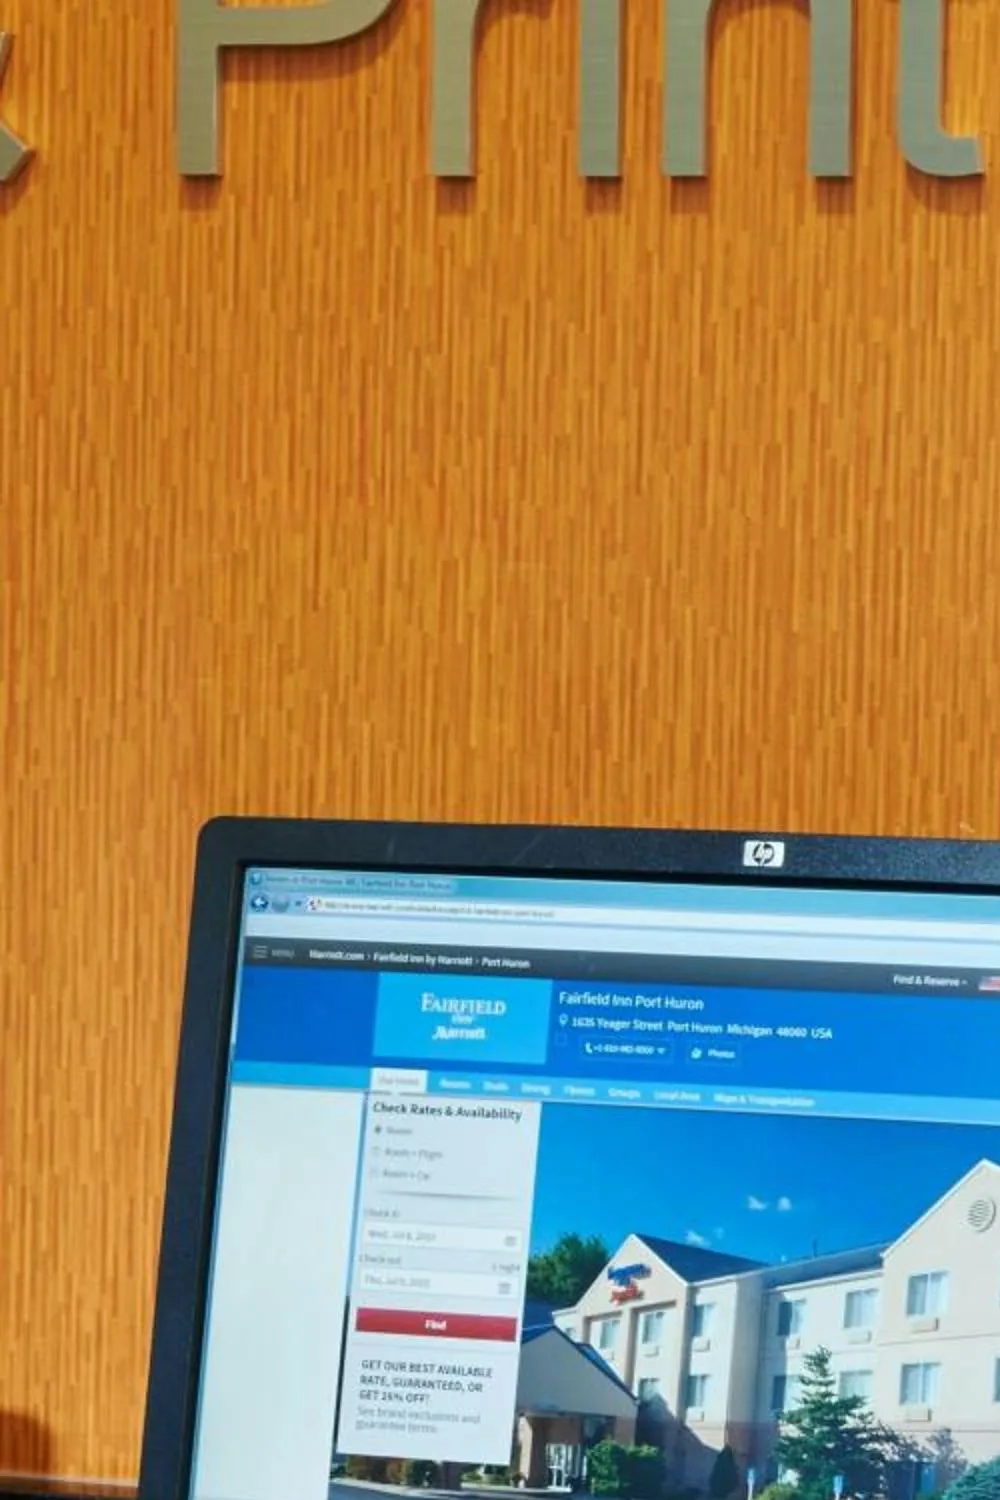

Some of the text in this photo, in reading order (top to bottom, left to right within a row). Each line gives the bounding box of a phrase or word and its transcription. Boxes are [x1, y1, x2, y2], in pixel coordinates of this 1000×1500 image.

[559, 991, 705, 1012] Fairfield Inn Port Huron
[596, 1017, 631, 1032] Yeager
[633, 1019, 663, 1033] Street
[667, 1021, 690, 1033] Port
[691, 1022, 723, 1034] Huron
[727, 1023, 773, 1038] Michigan
[811, 1027, 833, 1039] USA
[373, 1102, 407, 1115] Check
[410, 1104, 442, 1117] Rates
[455, 1107, 523, 1123] Availability
[361, 1360, 382, 1370] GET
[409, 1362, 436, 1374] BEST
[437, 1364, 493, 1379] AVAILABLE
